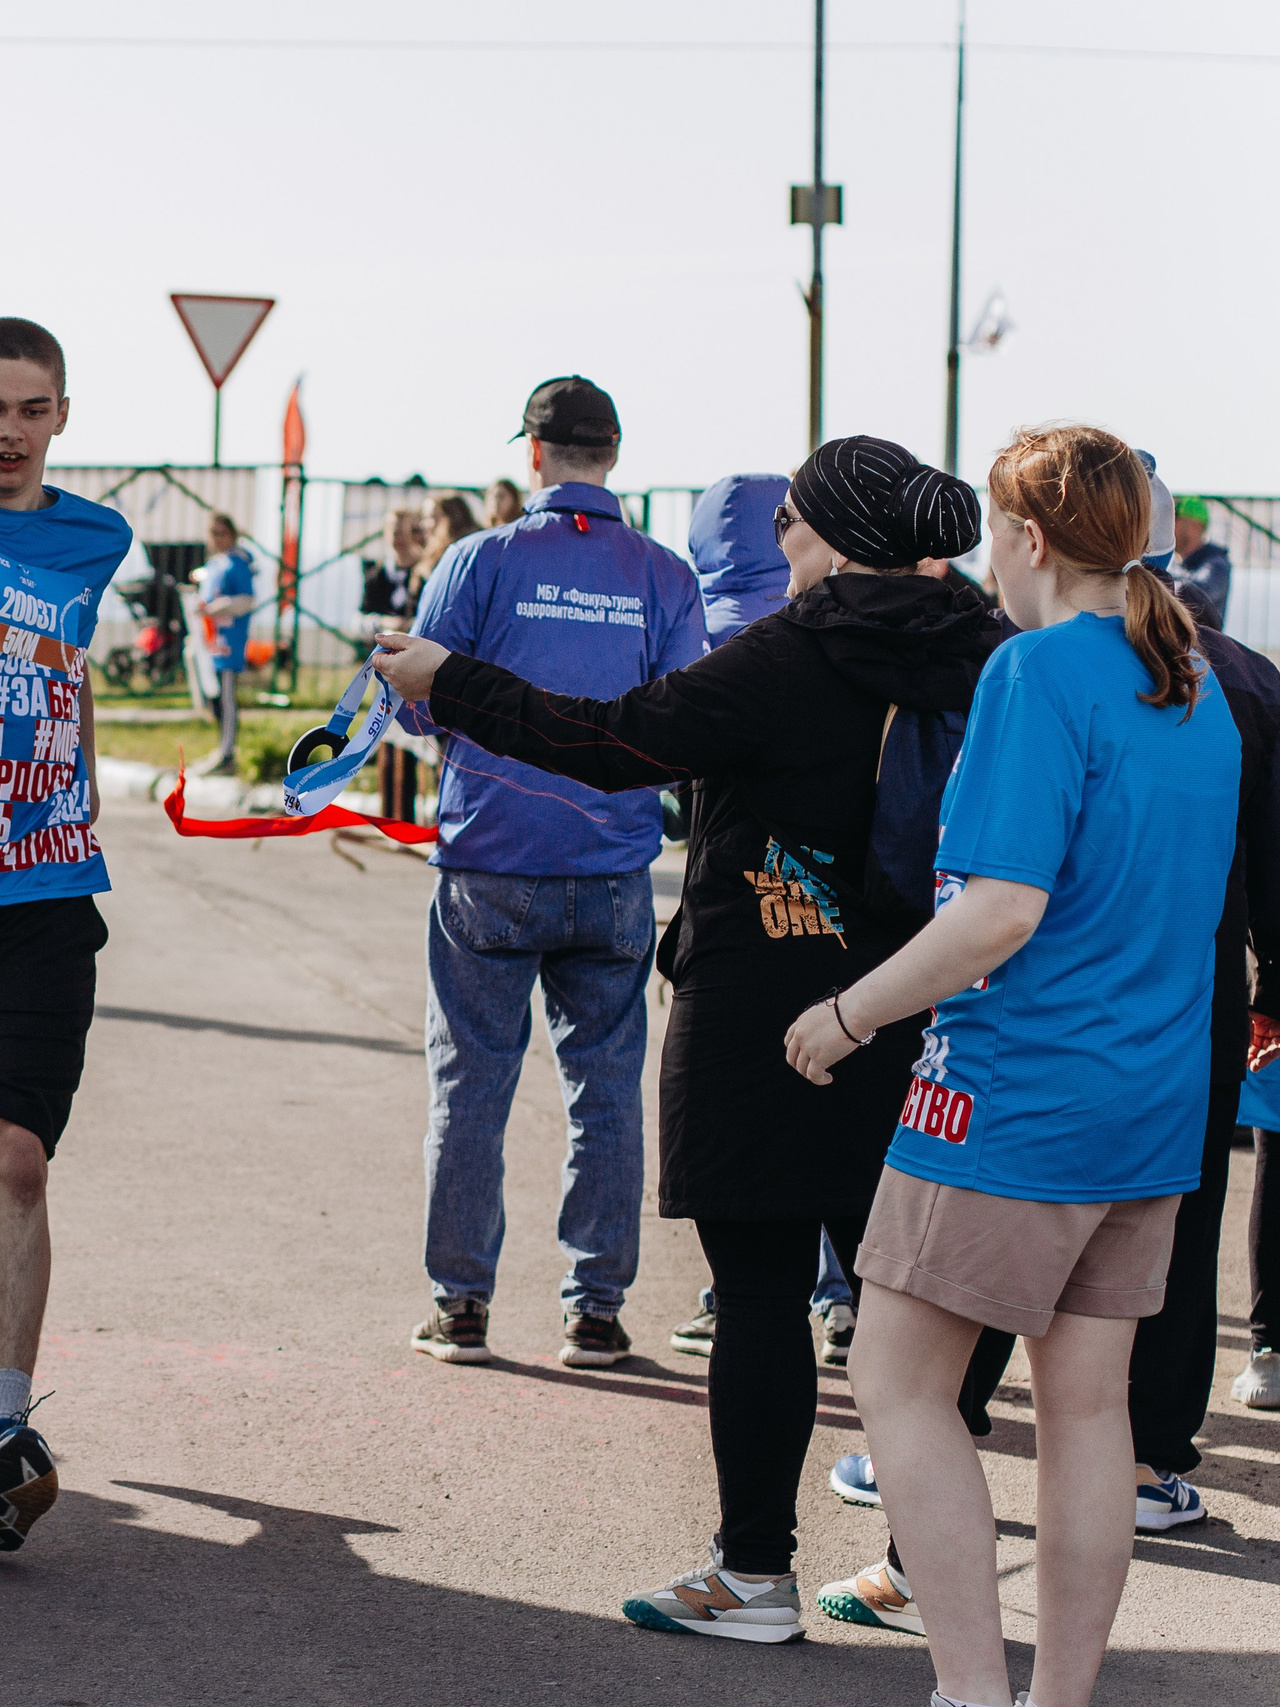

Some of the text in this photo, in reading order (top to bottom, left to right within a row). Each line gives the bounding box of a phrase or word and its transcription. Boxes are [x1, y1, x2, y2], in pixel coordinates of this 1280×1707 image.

[536, 583, 560, 601] МБУ
[516, 601, 648, 629] оздоровительный компле
[760, 894, 845, 939] ONE
[900, 1076, 975, 1145] СТВО
